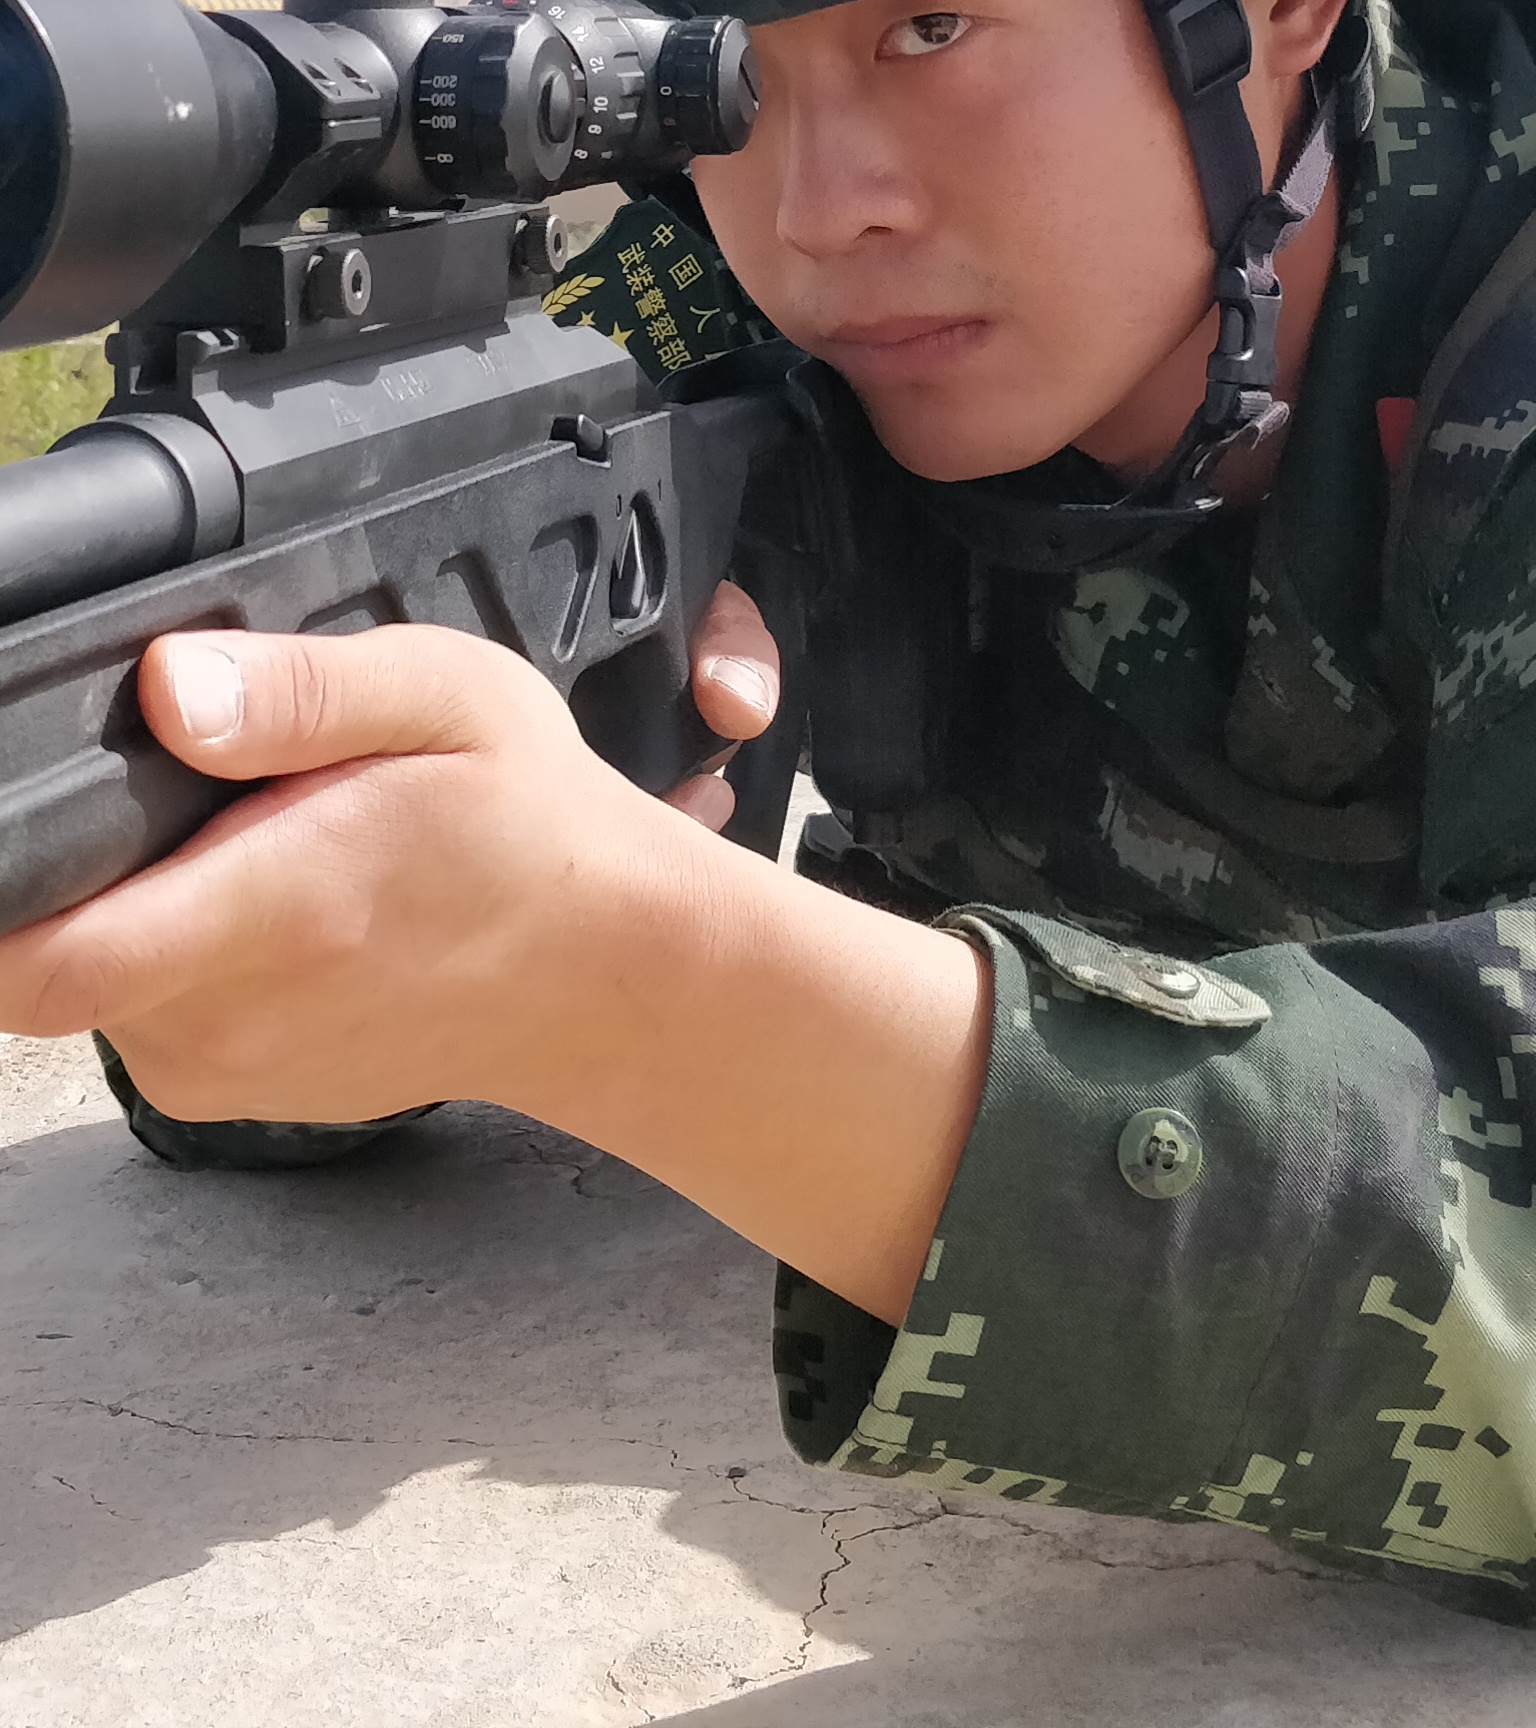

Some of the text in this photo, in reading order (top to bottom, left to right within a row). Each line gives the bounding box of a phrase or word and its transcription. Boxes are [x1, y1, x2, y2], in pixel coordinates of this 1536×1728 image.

[548, 5, 567, 20] 16
[589, 56, 605, 74] 12
[593, 96, 609, 113] 10
[574, 149, 588, 159] 8
[651, 223, 721, 360] 中国人
